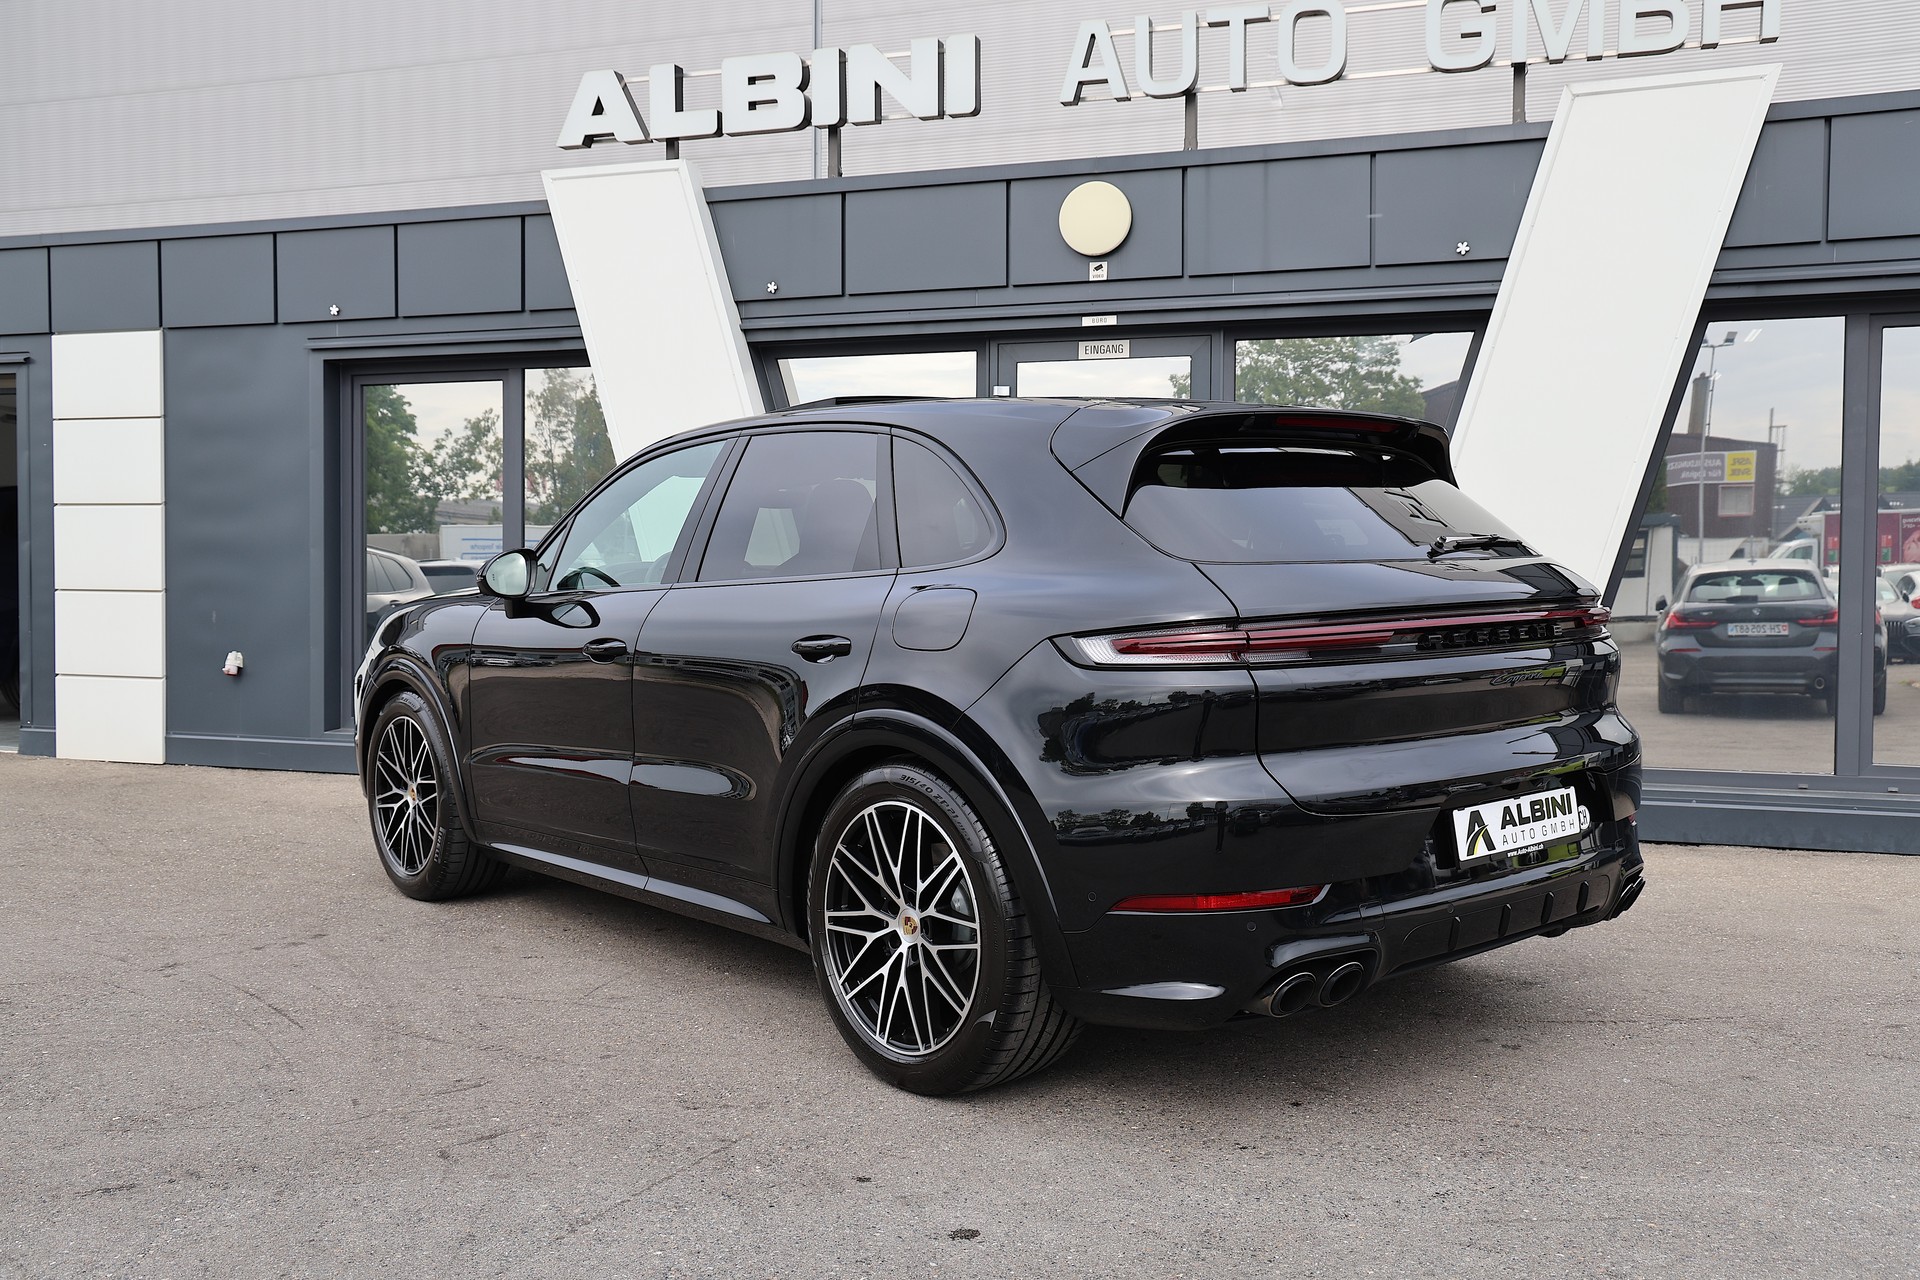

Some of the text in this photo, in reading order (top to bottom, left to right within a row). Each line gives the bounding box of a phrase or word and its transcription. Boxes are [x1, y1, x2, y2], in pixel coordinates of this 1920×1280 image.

[556, 33, 982, 150] ALBINI
[1060, 0, 1348, 106] AUTO
[1084, 344, 1124, 355] EINGANG
[1500, 792, 1573, 831] ALBINI
[1502, 818, 1576, 846] AUTO GMBH
